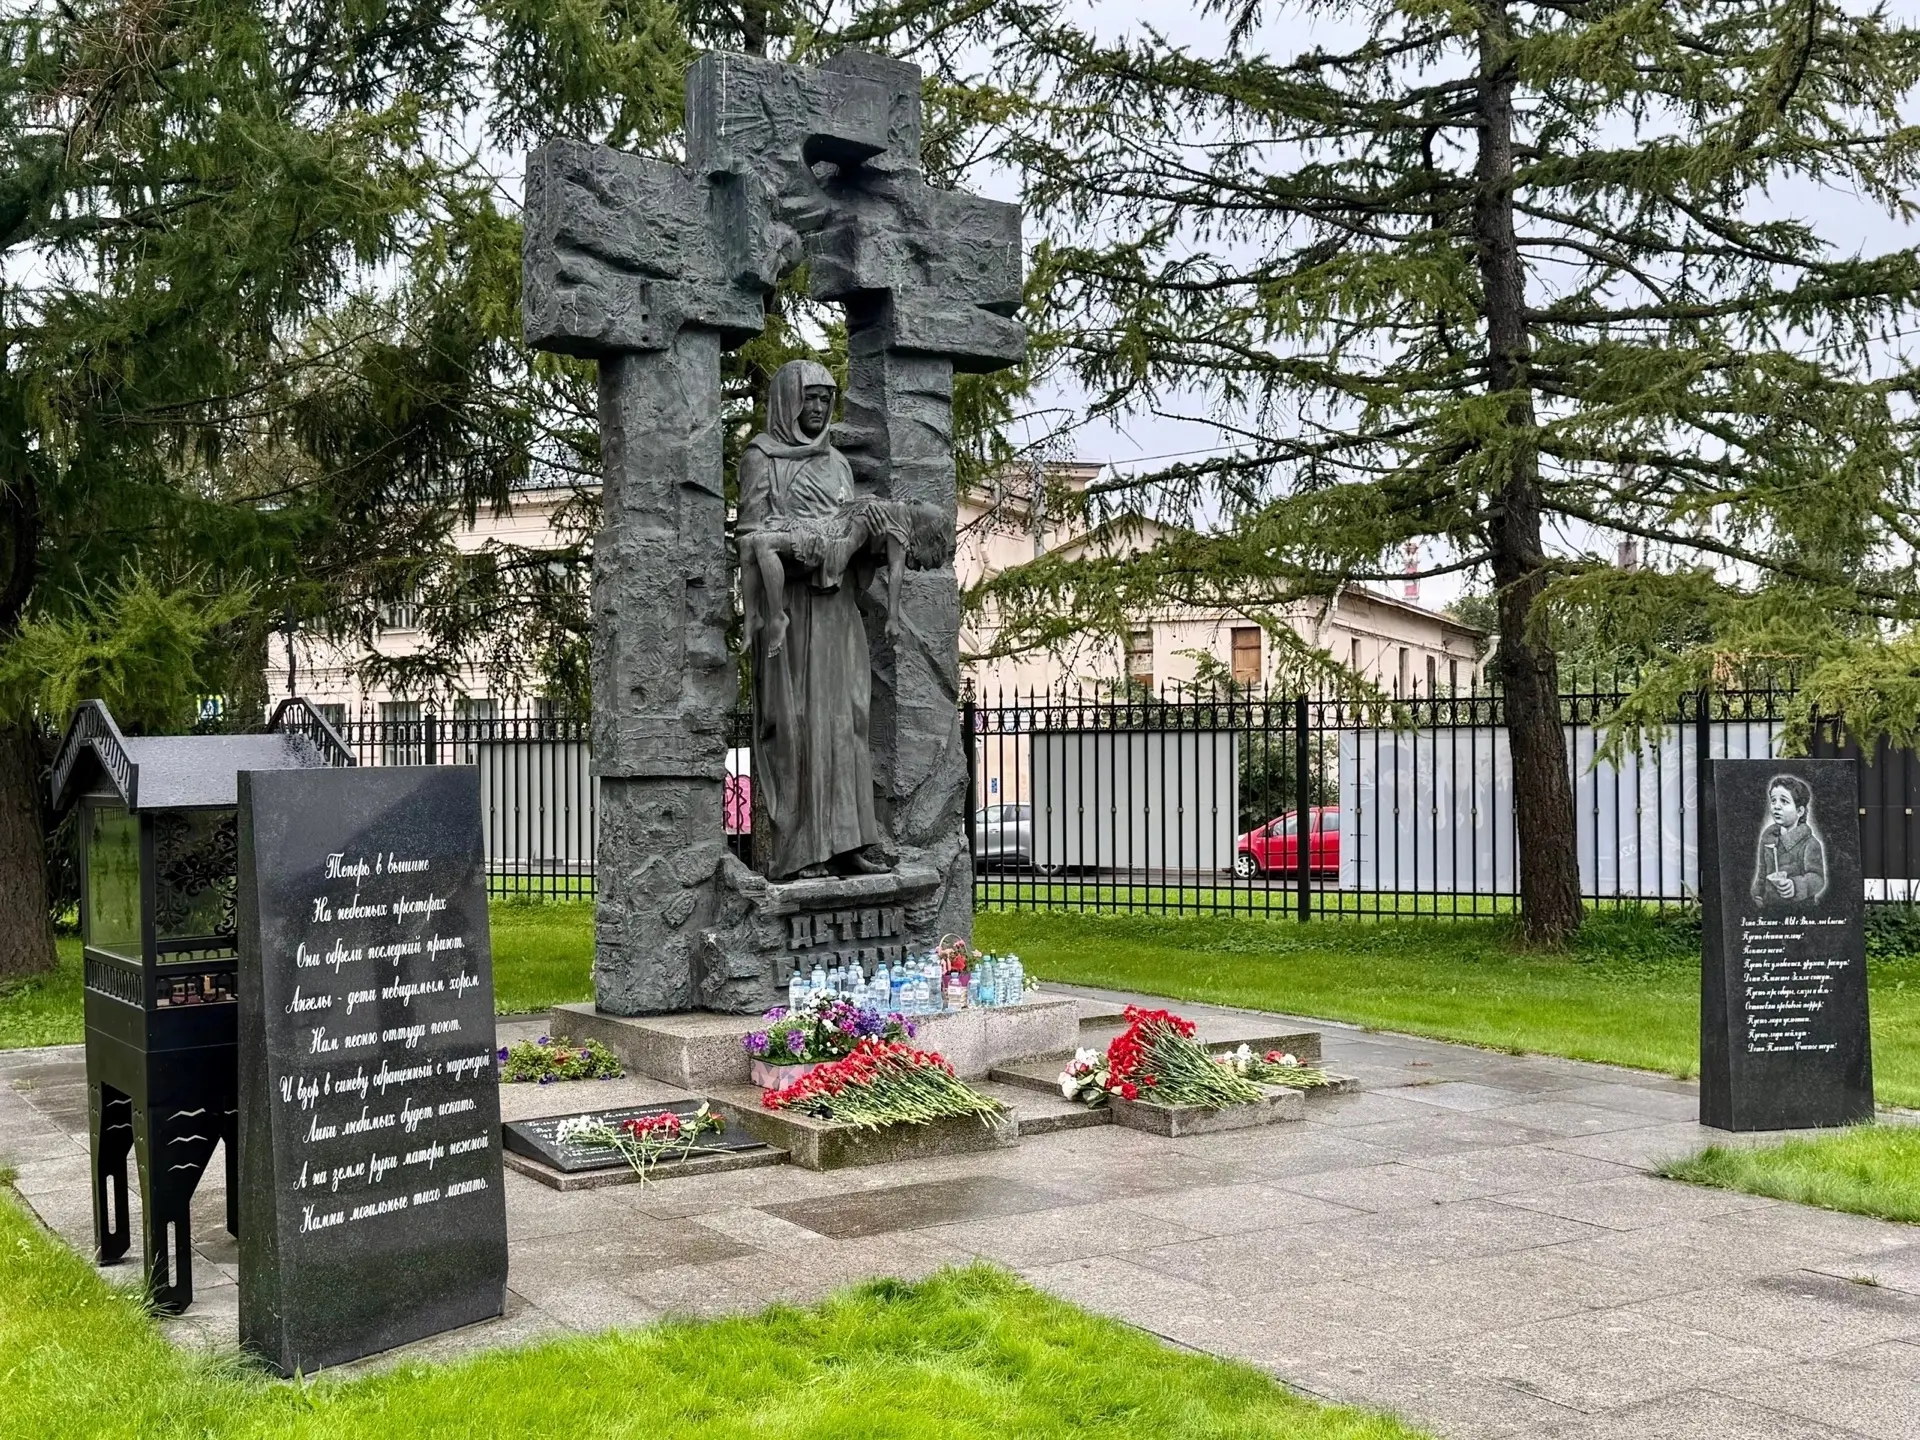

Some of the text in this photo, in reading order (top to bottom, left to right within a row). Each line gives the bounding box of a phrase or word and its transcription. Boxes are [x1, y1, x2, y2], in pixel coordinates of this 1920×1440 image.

[324, 852, 430, 886] Теперь в вышине
[312, 893, 447, 924] На небесных просторах
[790, 907, 905, 950] ДЕТЯМ
[297, 934, 465, 974] Они обрели последний приют.
[285, 986, 332, 1014] Ангелы
[346, 991, 376, 1015] дети
[381, 976, 444, 1006] невидимым
[449, 970, 479, 998] хором
[309, 1019, 462, 1054] Нам песню оттуда поют.
[280, 1049, 490, 1110] И взор в синеву обращенный с надеждой
[303, 1098, 477, 1144] Лики любимых будет искать.
[293, 1130, 489, 1192] А на земле руки матери нежной
[300, 1176, 489, 1233] Камни могильные тихо ласкать.
